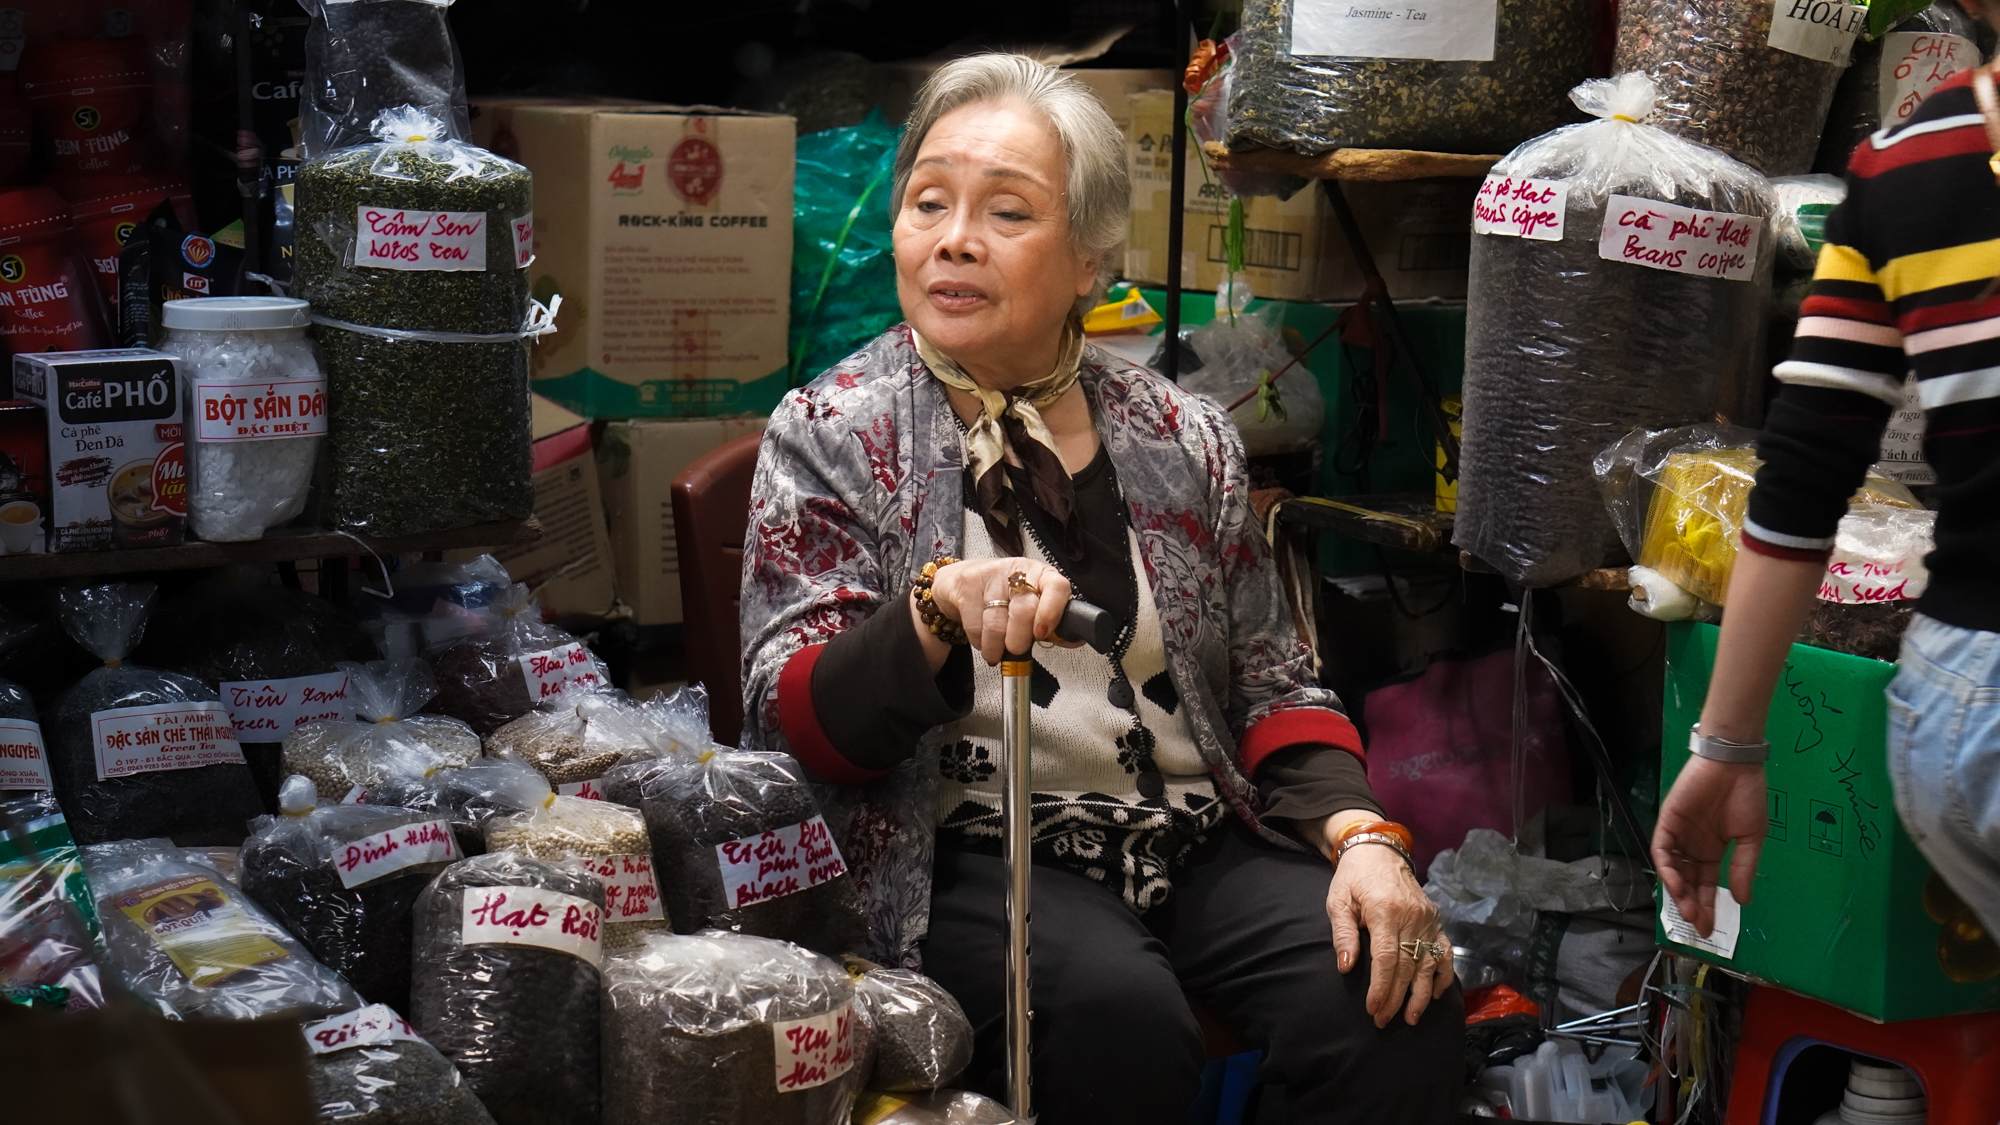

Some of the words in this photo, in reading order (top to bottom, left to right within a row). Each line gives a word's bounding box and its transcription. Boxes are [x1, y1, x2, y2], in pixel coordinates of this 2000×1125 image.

[1346, 6, 1393, 19] Jasmine
[1405, 9, 1427, 20] Tea
[78, 157, 110, 170] Coffee
[1475, 197, 1507, 224] Beans
[431, 213, 482, 237] Sen
[710, 215, 768, 228] COFFEE
[1622, 234, 1687, 269] Beans
[16, 281, 69, 305] TÙNG
[14, 307, 45, 320] Coffee
[65, 389, 102, 410] Café
[103, 370, 170, 409] PHỐ
[205, 393, 248, 426] BỘT
[253, 384, 292, 421] SẮN
[298, 388, 327, 418] DÂY
[81, 425, 102, 440] phê
[237, 423, 269, 437] ĐẶC
[273, 421, 310, 434] BIỆT
[75, 439, 103, 453] Đen
[105, 435, 125, 449] Đá
[153, 714, 178, 726] TÀI
[184, 714, 215, 724] MINH
[106, 730, 132, 750] ĐẶC
[135, 727, 160, 746] SẢN
[163, 724, 187, 744] CHÈ
[189, 723, 213, 743] THÁI
[0, 742, 41, 760] NGUYÊN
[160, 744, 196, 753] Green
[199, 742, 216, 750] Tea
[736, 875, 800, 908] Black
[471, 892, 550, 937] Hạt
